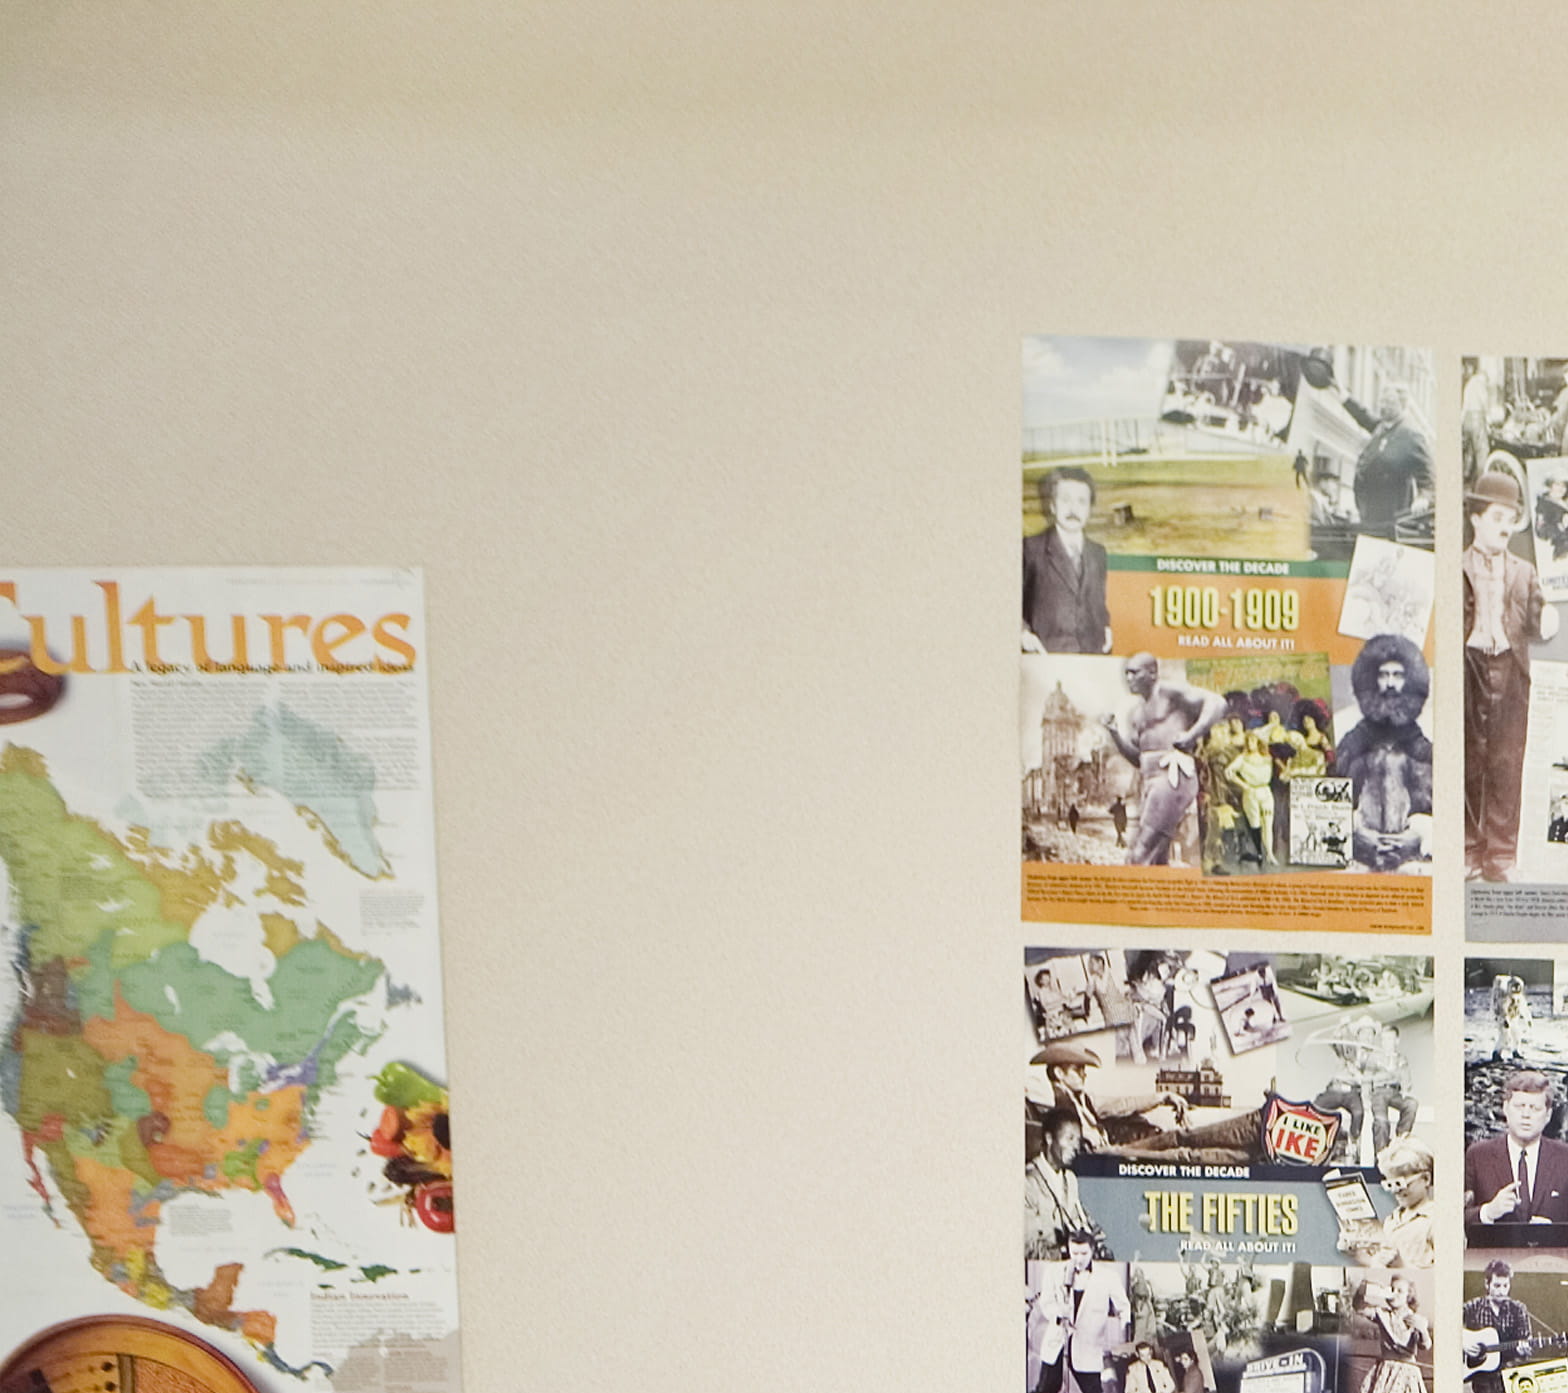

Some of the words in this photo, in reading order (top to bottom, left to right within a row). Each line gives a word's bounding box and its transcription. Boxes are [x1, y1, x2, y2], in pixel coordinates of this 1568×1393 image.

[1157, 559, 1216, 573] DISCOVER
[1220, 561, 1241, 573] THE
[1244, 561, 1289, 574] DECADE
[1149, 585, 1299, 630] 1900-1909
[0, 580, 416, 674] ultures
[1291, 1119, 1321, 1133] LIKE
[1275, 1129, 1320, 1159] IKE
[1119, 1165, 1178, 1178] DISCOVER
[1181, 1165, 1203, 1178] THE
[1205, 1166, 1250, 1179] DECADE
[1144, 1191, 1194, 1234] THE
[1202, 1193, 1298, 1236] FIFTIES
